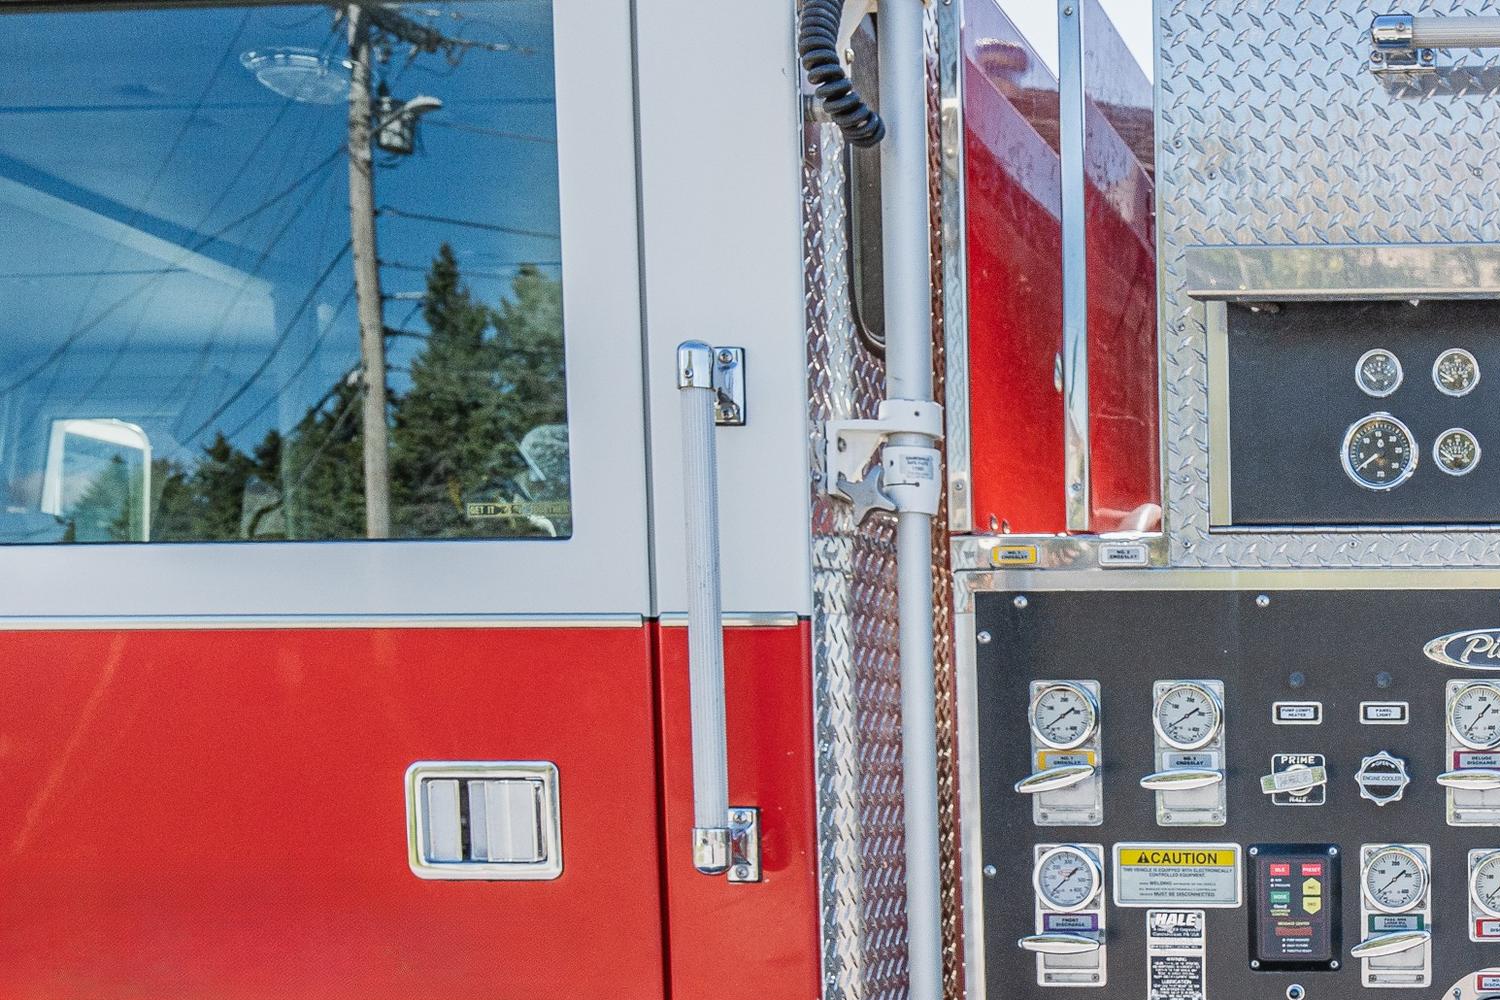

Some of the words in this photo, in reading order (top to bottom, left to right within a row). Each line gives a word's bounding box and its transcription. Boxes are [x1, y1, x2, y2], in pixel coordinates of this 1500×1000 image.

[1280, 756, 1316, 764] PRIME
[1150, 852, 1218, 864] CAUTION
[1155, 913, 1197, 927] HALE
